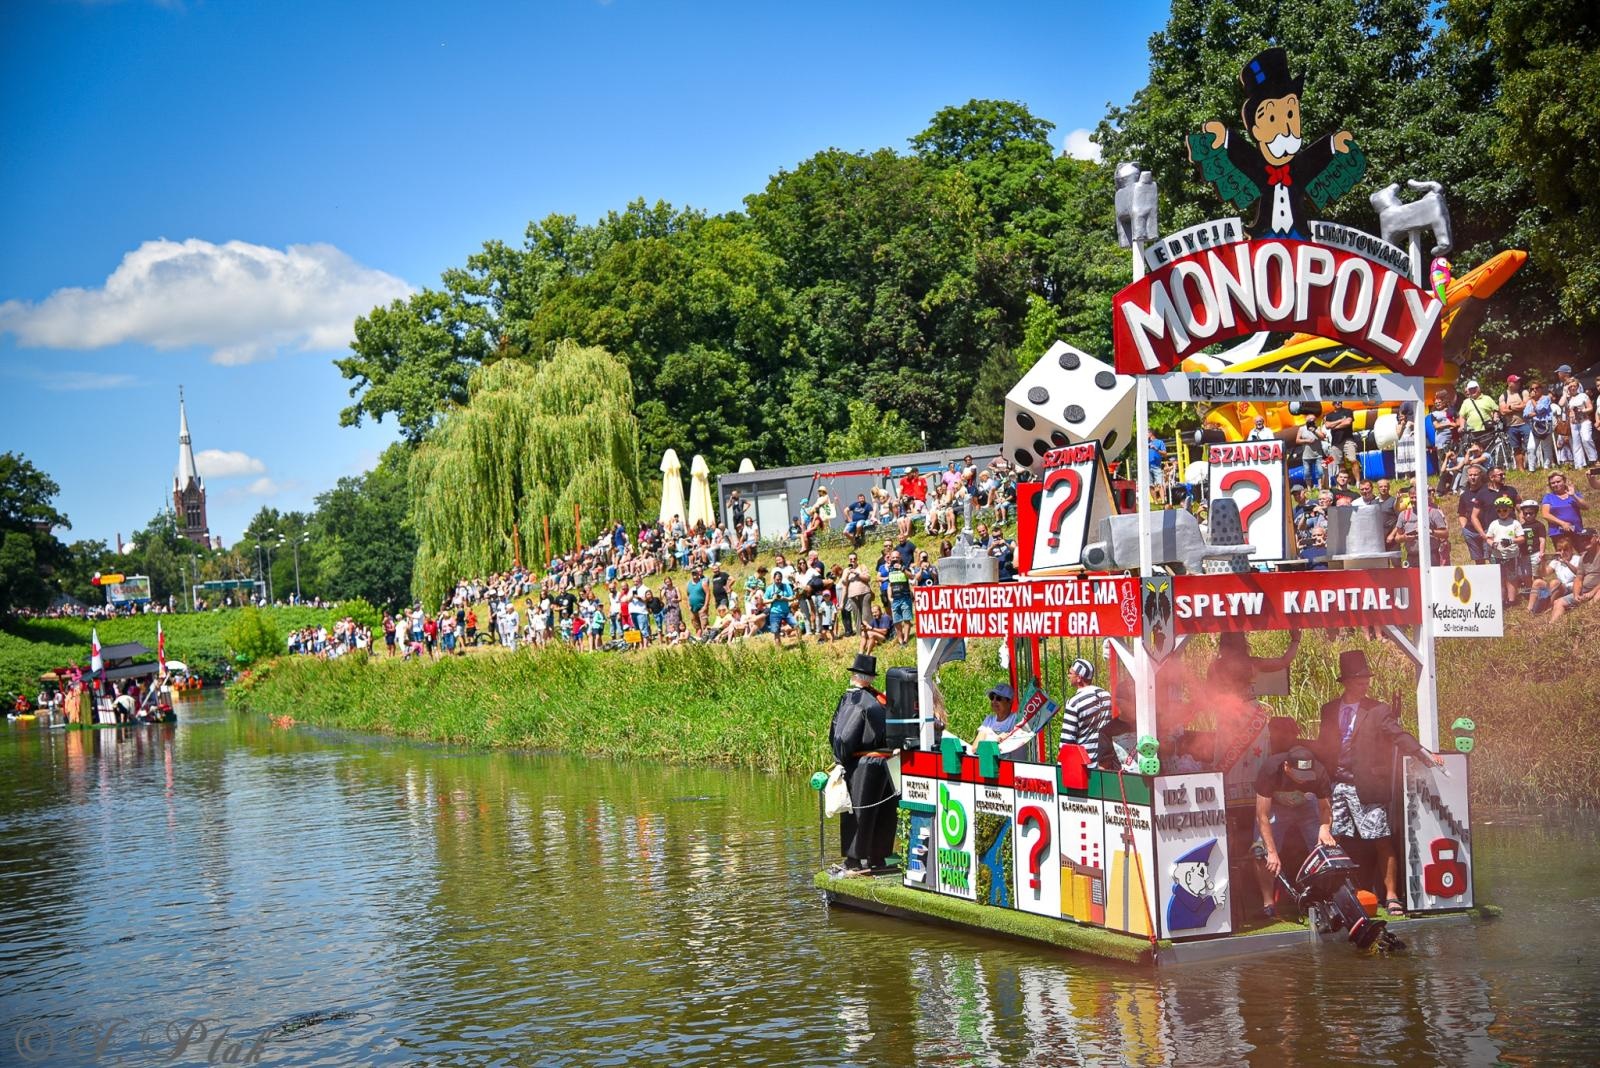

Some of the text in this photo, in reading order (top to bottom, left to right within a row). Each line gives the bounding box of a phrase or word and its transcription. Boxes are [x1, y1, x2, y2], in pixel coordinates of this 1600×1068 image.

[1154, 222, 1235, 263] EDYCJA
[1315, 224, 1411, 273] LIMITOWANA
[1121, 242, 1443, 370] MONOPOLY
[1319, 374, 1378, 397] KOŹLE
[1043, 444, 1096, 468] SZANSA
[1209, 444, 1283, 464] SZANSA
[1044, 469, 1081, 548] ?
[915, 591, 929, 611] 50
[932, 589, 952, 610] LAT
[1094, 581, 1118, 605] MA
[1176, 587, 1409, 618] SPŁYW KAPITAŁU
[919, 609, 1100, 639] NALEŻY MU SIĘ NAWET GRA
[1022, 694, 1042, 719] POLY
[1163, 782, 1215, 806] IDŹ DO
[1062, 802, 1099, 815] BLACHOWNIA
[1154, 809, 1227, 832] WIĘZIENIA
[1416, 779, 1470, 840] PARKING
[939, 847, 971, 869] RADIO
[941, 868, 969, 889] PARK
